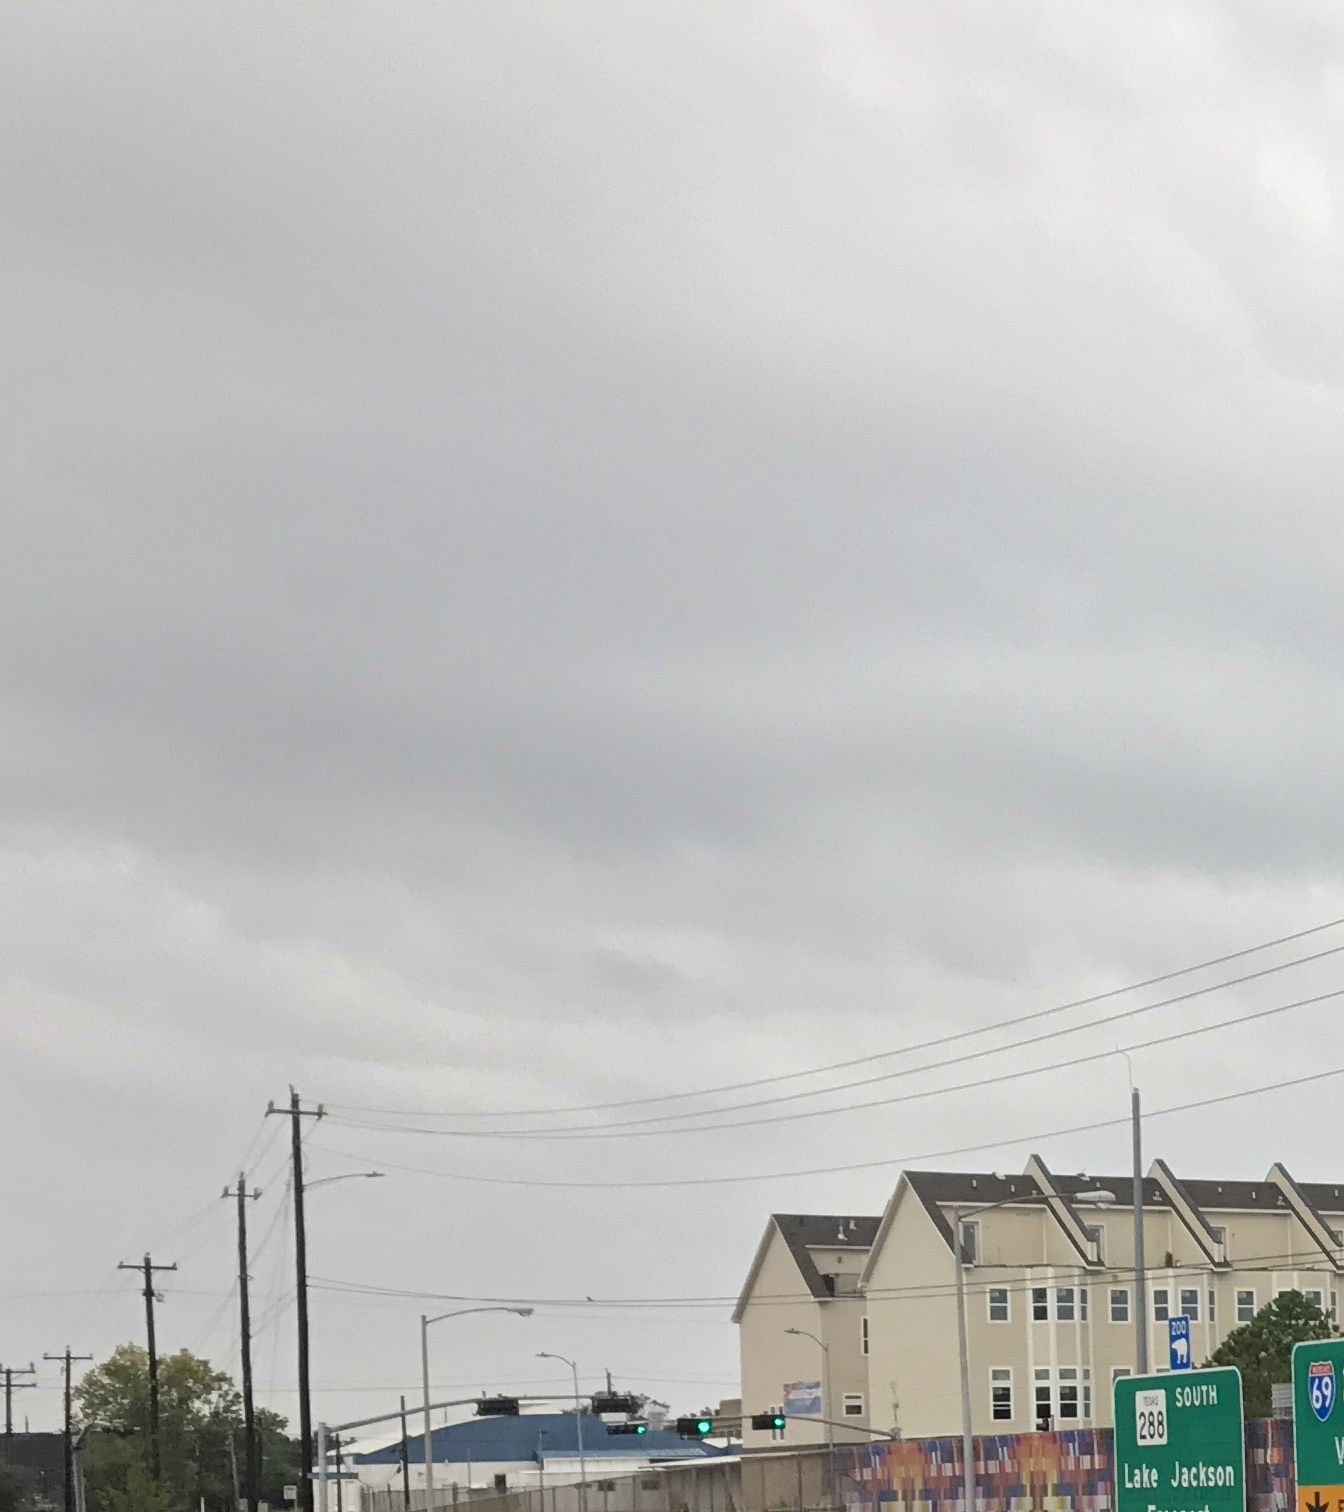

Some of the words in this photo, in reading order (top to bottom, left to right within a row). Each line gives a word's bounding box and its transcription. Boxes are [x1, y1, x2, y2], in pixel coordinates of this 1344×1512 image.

[1171, 1320, 1187, 1336] ZOO
[1175, 1384, 1218, 1407] SOUTH
[1312, 1376, 1332, 1410] 69
[1139, 1410, 1165, 1440] 288
[1124, 1462, 1158, 1489] Lake
[1170, 1460, 1235, 1488] Jackson
